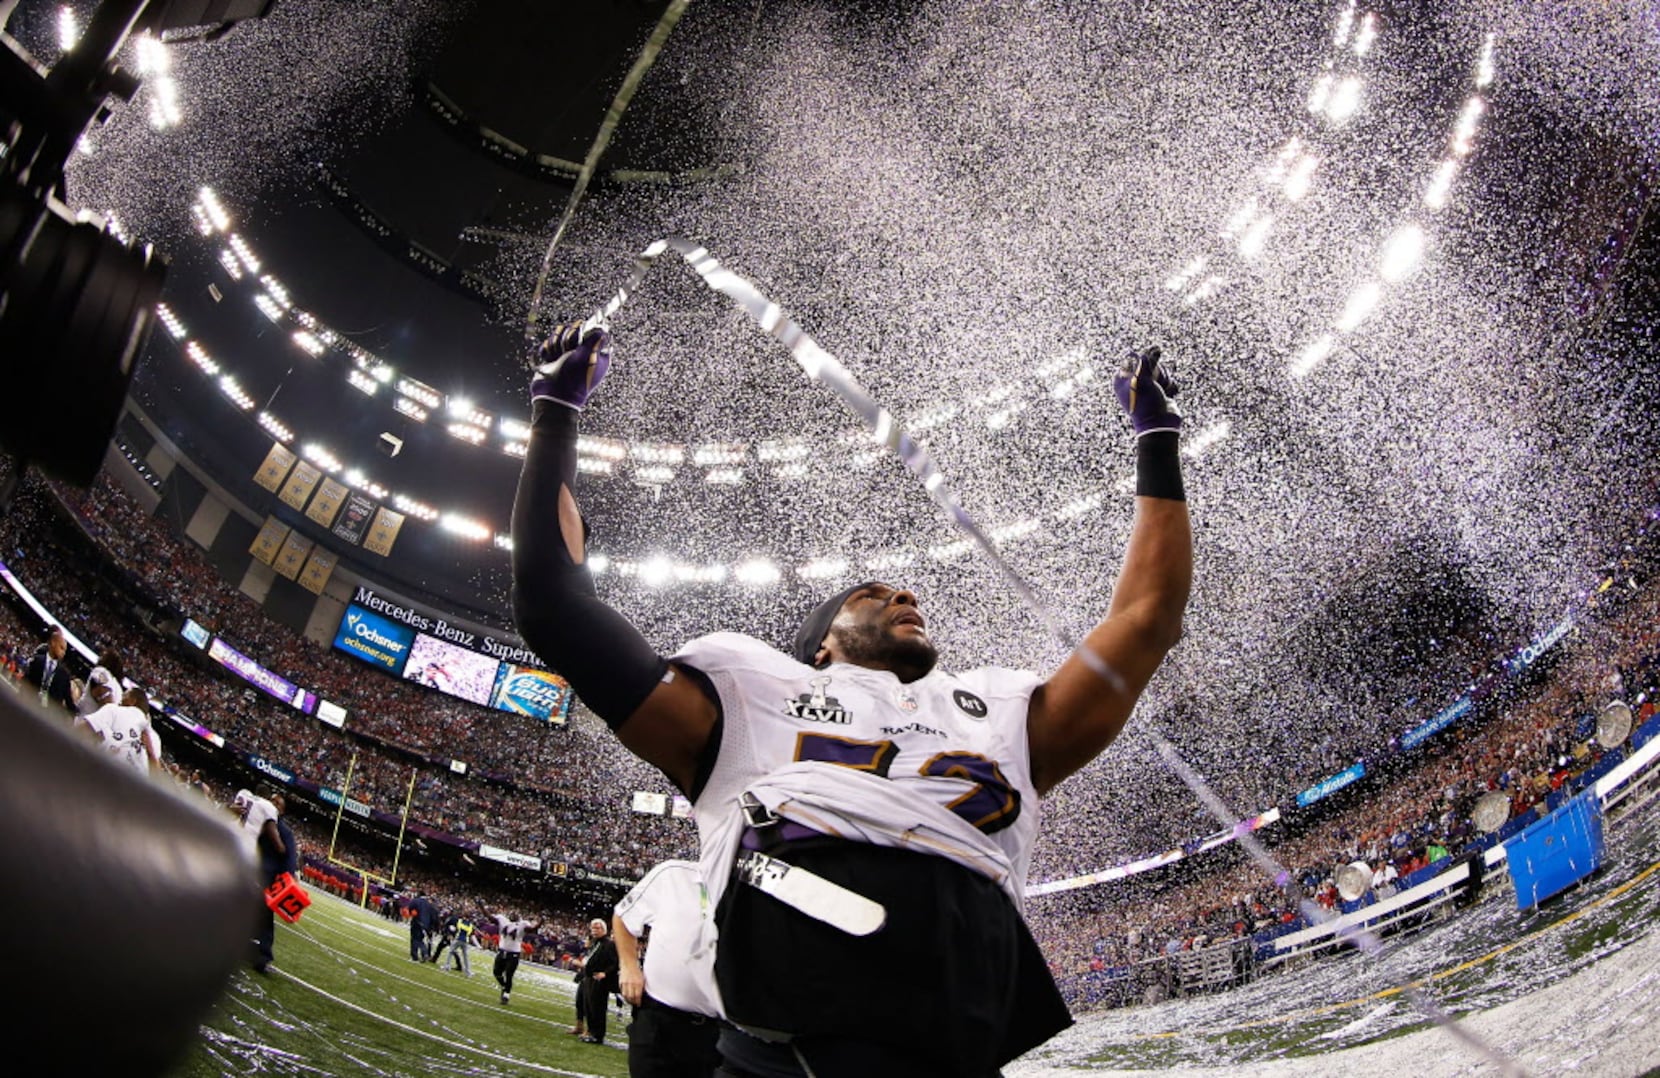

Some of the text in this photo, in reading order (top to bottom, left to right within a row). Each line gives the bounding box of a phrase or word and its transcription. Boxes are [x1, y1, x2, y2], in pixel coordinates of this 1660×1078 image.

[354, 586, 547, 667] Mercedes-Benz Super
[355, 622, 404, 653] Ochsner
[343, 635, 397, 667] ochsner.org
[516, 679, 560, 701] BUD
[781, 697, 853, 725] XLVII
[880, 722, 948, 739] RAVENS
[256, 758, 292, 783] Ochsner
[1320, 771, 1355, 799] Allstate
[506, 856, 539, 868] verizon
